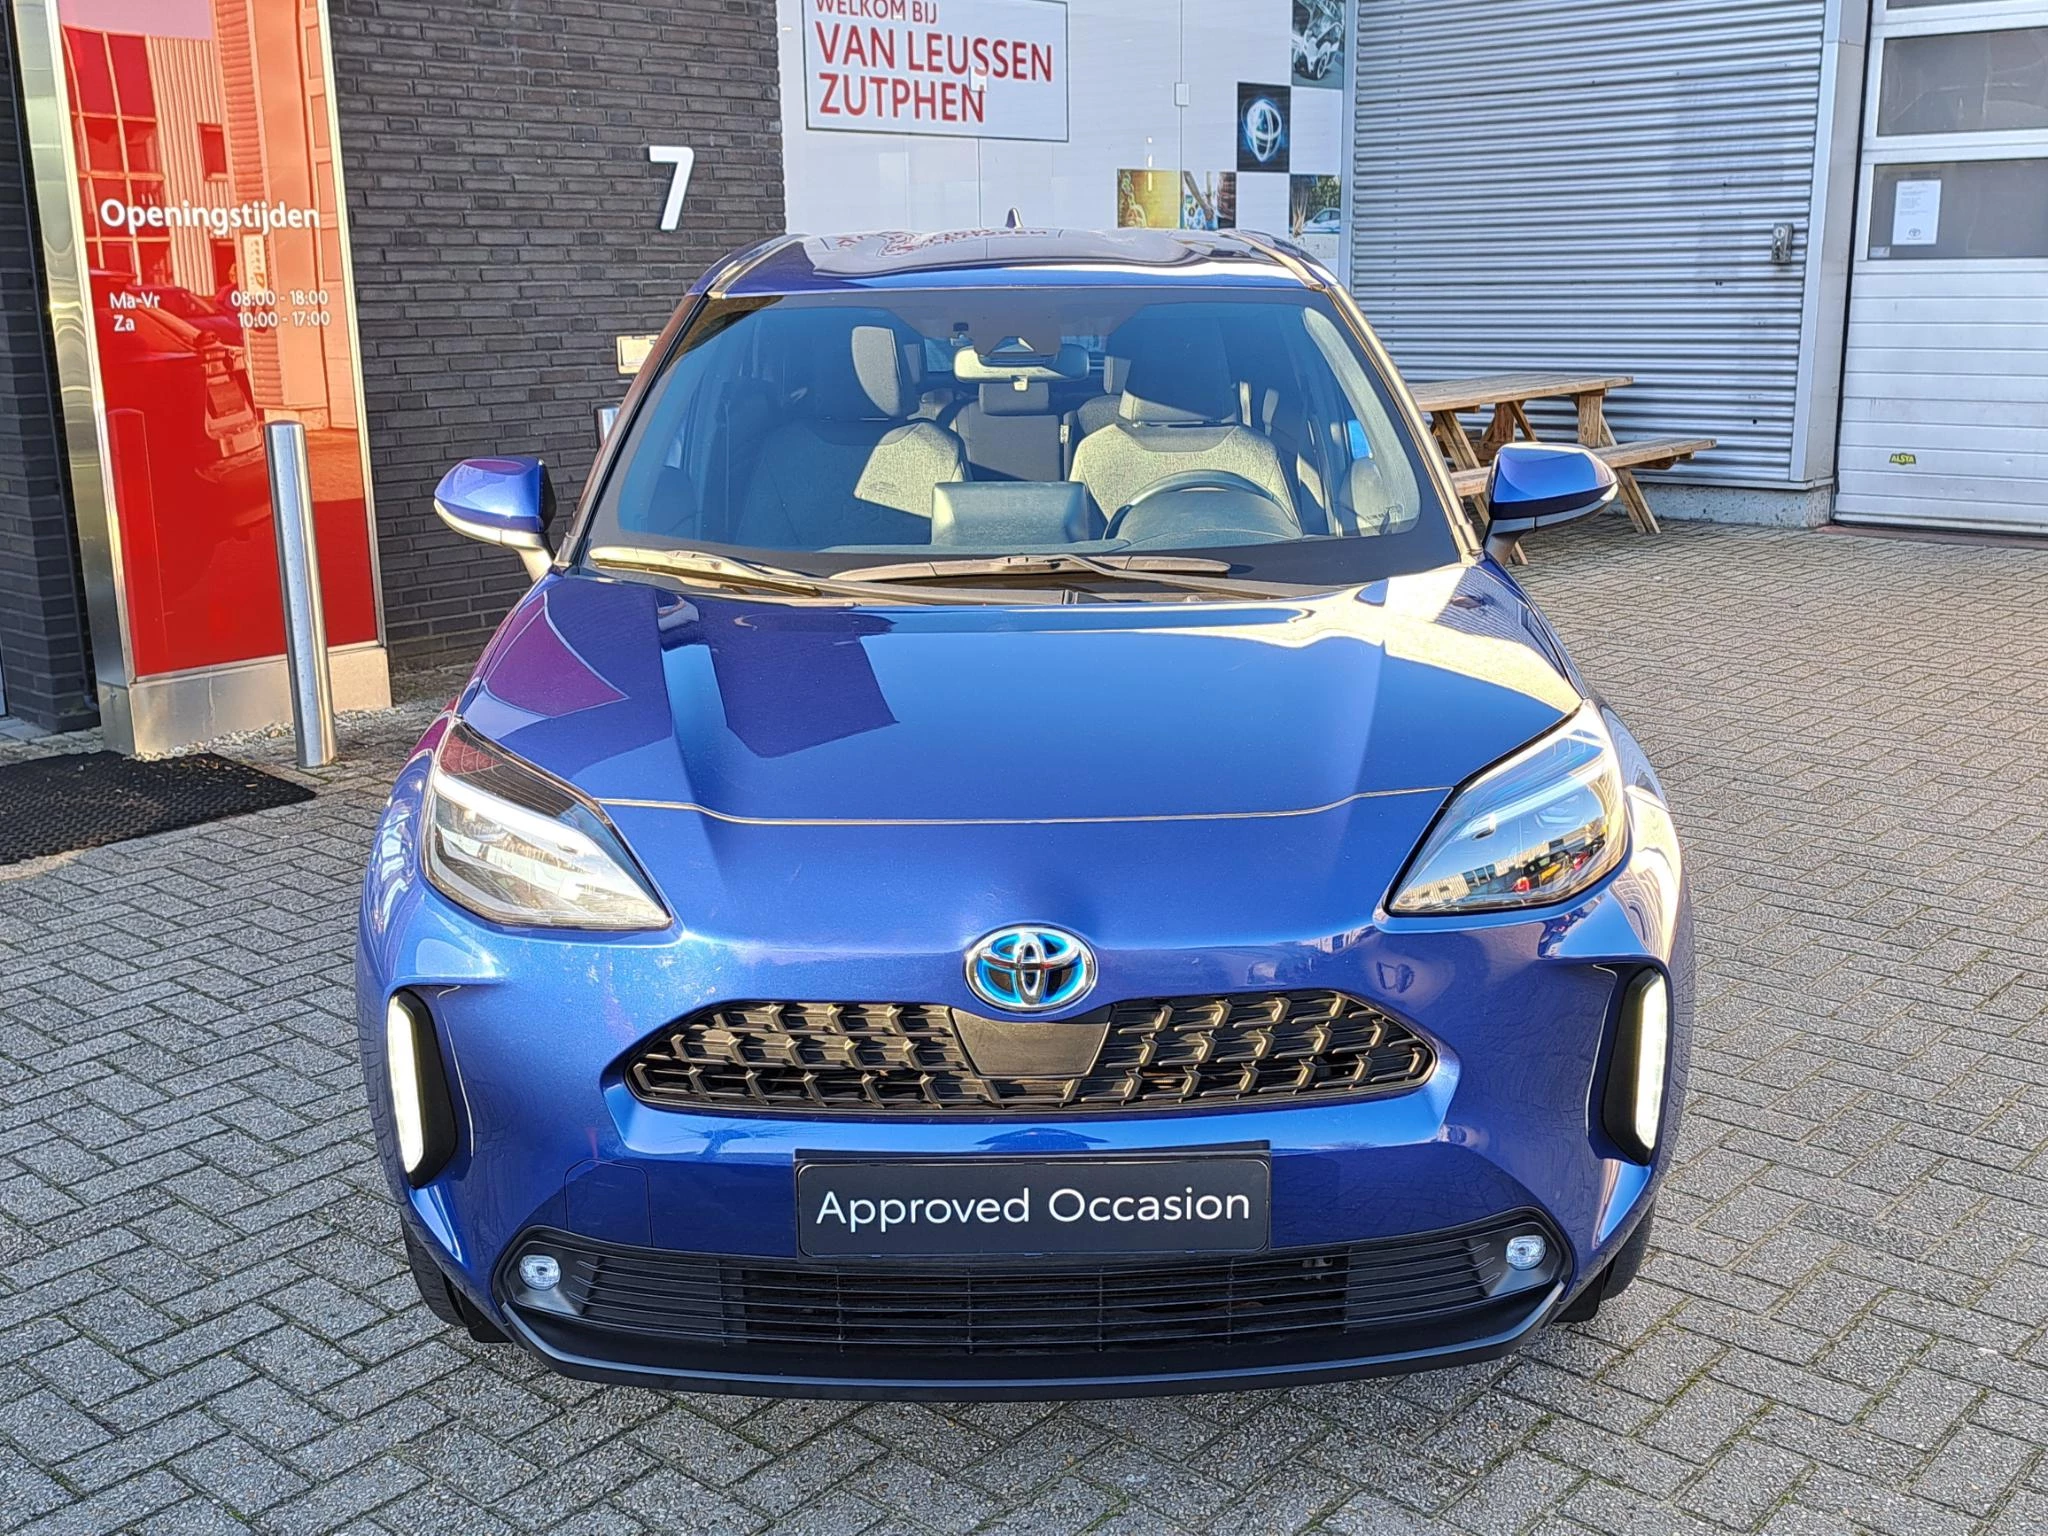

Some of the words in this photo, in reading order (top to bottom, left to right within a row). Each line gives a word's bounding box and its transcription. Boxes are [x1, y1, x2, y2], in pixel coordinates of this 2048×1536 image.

[816, 0, 907, 21] WELKOM
[912, 1, 938, 25] BIJ
[814, 20, 895, 69] VAN
[907, 30, 1052, 82] LEUSSEN
[818, 72, 985, 123] ZUTPHEN
[648, 145, 695, 231] 7
[100, 198, 321, 236] Openingstijden
[109, 291, 161, 310] Ma-Vr
[231, 290, 276, 307] 08:00
[290, 289, 329, 306] 18:00
[113, 314, 136, 333] Za
[237, 312, 279, 328] 10:00
[292, 311, 331, 327] 17:00
[1890, 453, 1915, 464] ALSTA
[816, 1187, 1029, 1233] Approved
[1048, 1187, 1249, 1222] Occasion
